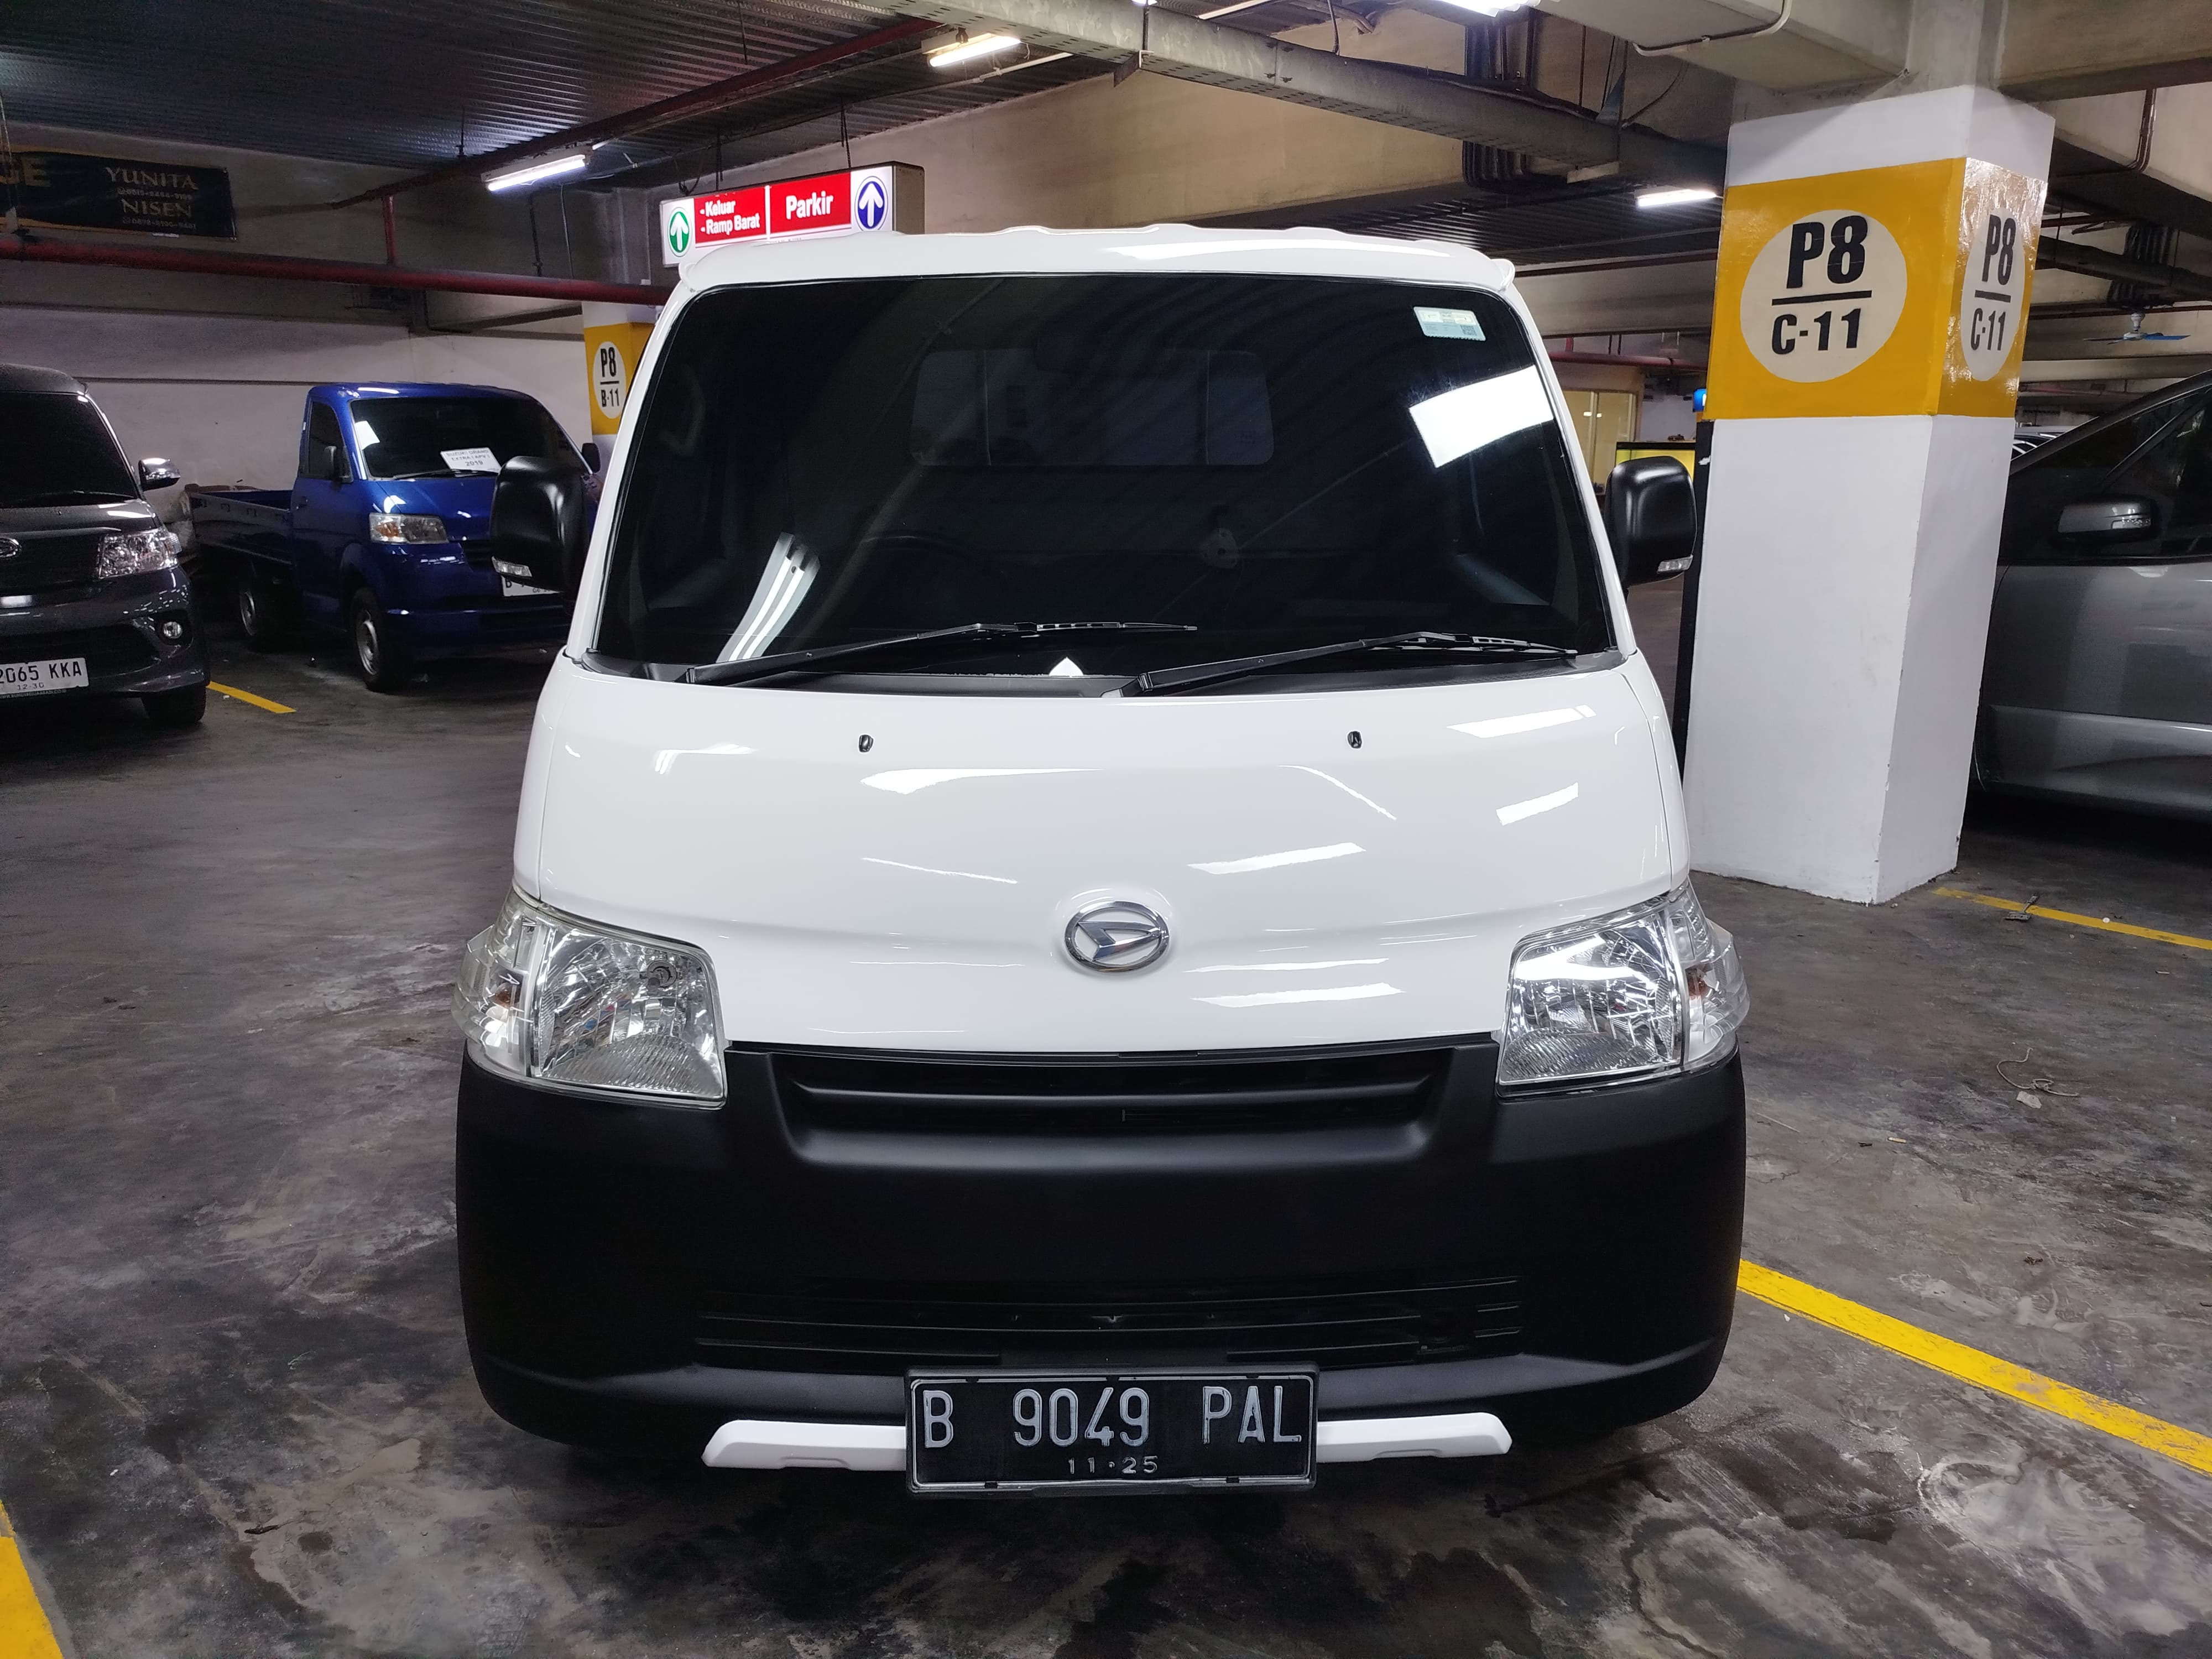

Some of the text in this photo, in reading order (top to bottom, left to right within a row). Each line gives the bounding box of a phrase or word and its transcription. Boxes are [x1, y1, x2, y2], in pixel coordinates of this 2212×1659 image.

[105, 166, 200, 190] YUNITA
[120, 198, 192, 217] NISEN
[785, 190, 834, 220] Parkir
[733, 212, 760, 231] Barat
[1786, 215, 1869, 289] P8
[1981, 214, 2017, 286] P8
[1771, 308, 1862, 355] C-11
[1970, 307, 2007, 351] C-11
[600, 347, 617, 378] P8
[49, 661, 82, 679] KKA
[923, 1385, 1302, 1448] B 9049 PAL
